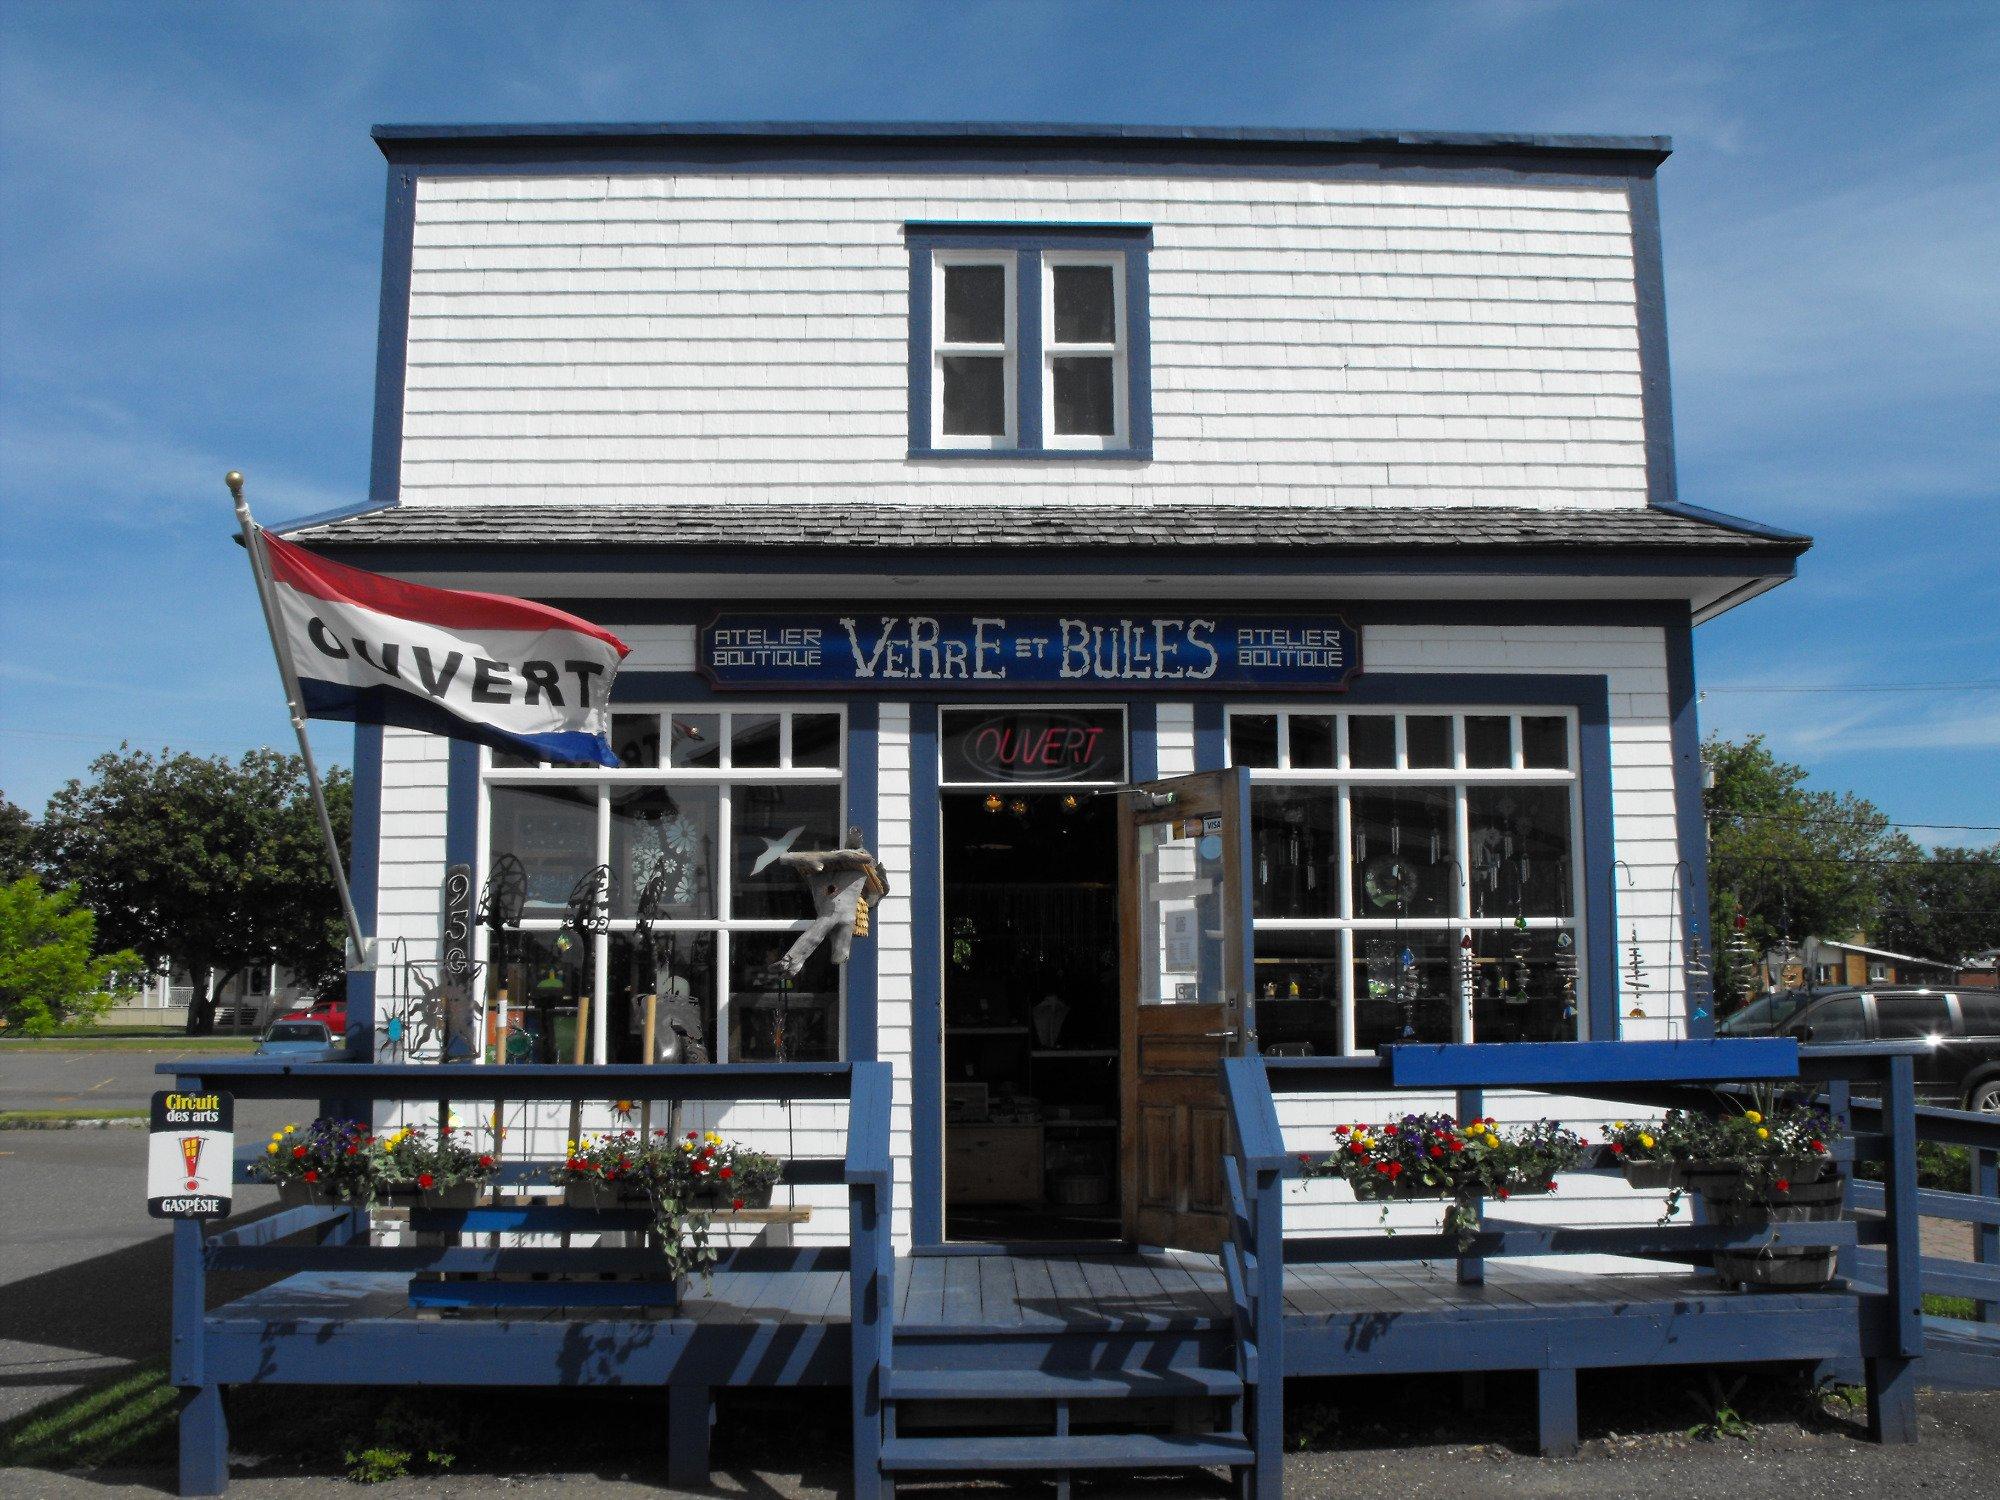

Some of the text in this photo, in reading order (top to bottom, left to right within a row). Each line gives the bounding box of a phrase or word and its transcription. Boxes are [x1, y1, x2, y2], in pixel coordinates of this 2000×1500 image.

[714, 628, 822, 646] ATELIER
[1237, 628, 1342, 647] ATELIER
[839, 616, 1219, 680] VERRE ET BULLES
[307, 616, 605, 708] OUVERT
[713, 650, 822, 667] BOUTIQUE
[1237, 650, 1343, 668] BOUTIQUE
[975, 726, 1104, 765] OUVERT
[1207, 820, 1221, 830] VISA
[165, 1093, 220, 1111] Circuit
[166, 1109, 219, 1123] des arts
[161, 1197, 219, 1212] GASPÉSIE
